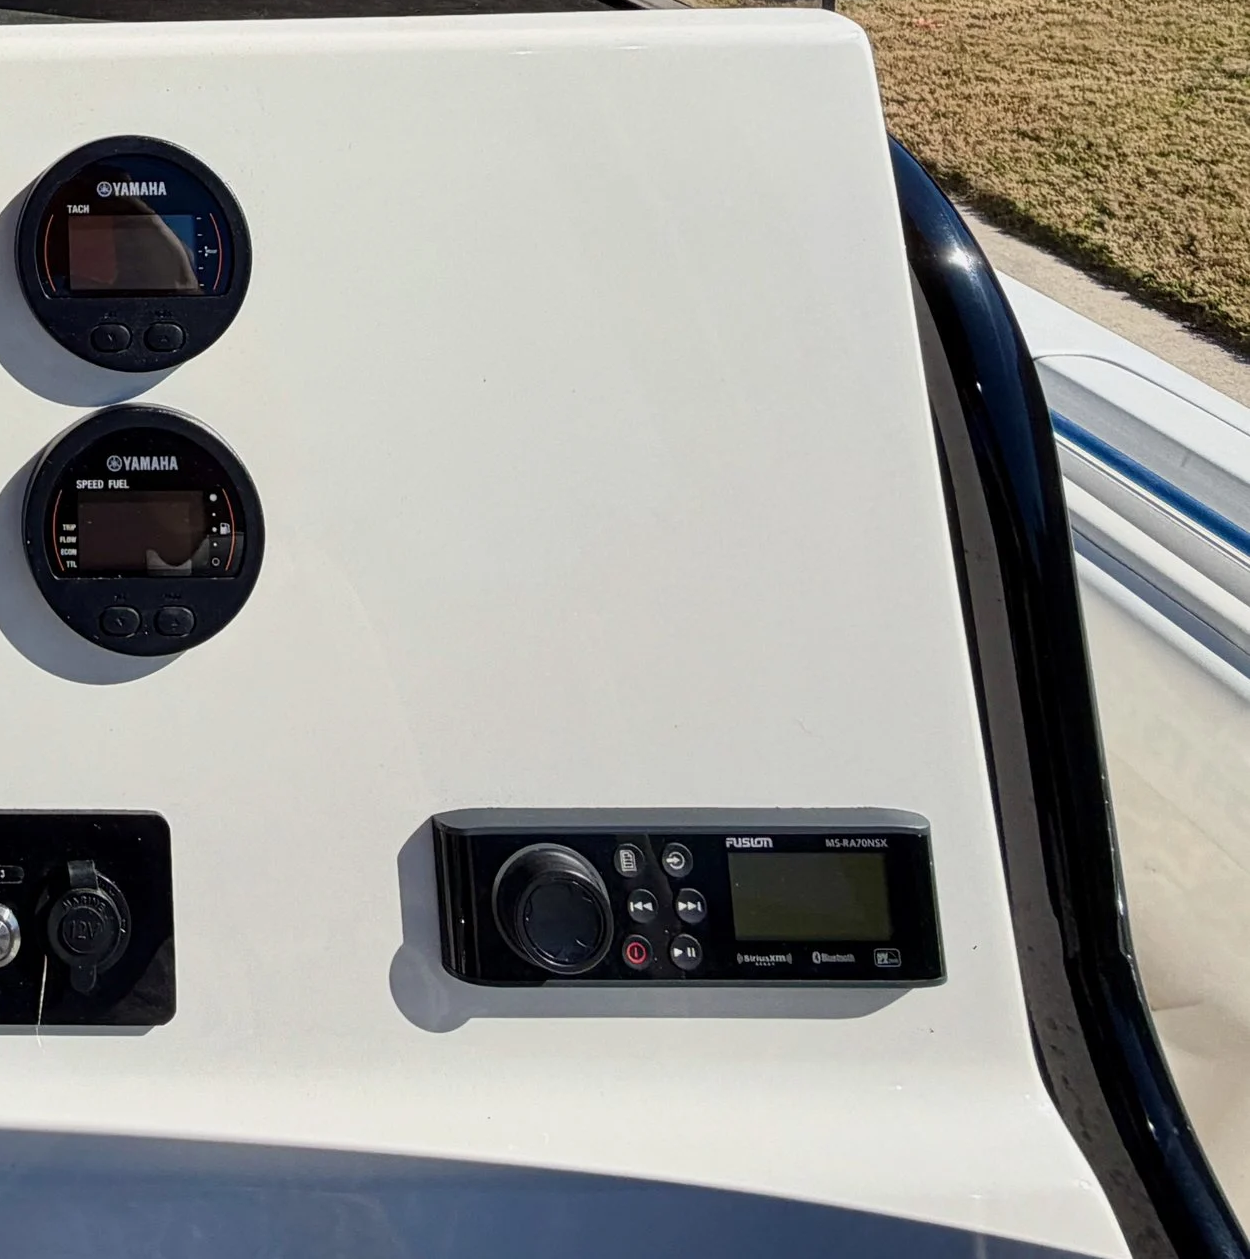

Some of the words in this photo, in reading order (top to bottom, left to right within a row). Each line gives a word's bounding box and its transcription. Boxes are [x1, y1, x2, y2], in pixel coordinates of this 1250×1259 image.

[112, 181, 167, 196] YAMAHA
[67, 204, 90, 214] TACH
[123, 456, 179, 471] YAMAHA
[76, 479, 104, 489] SPEED
[108, 479, 130, 489] FUEL
[725, 837, 774, 848] FUSION
[0, 869, 6, 878] 3
